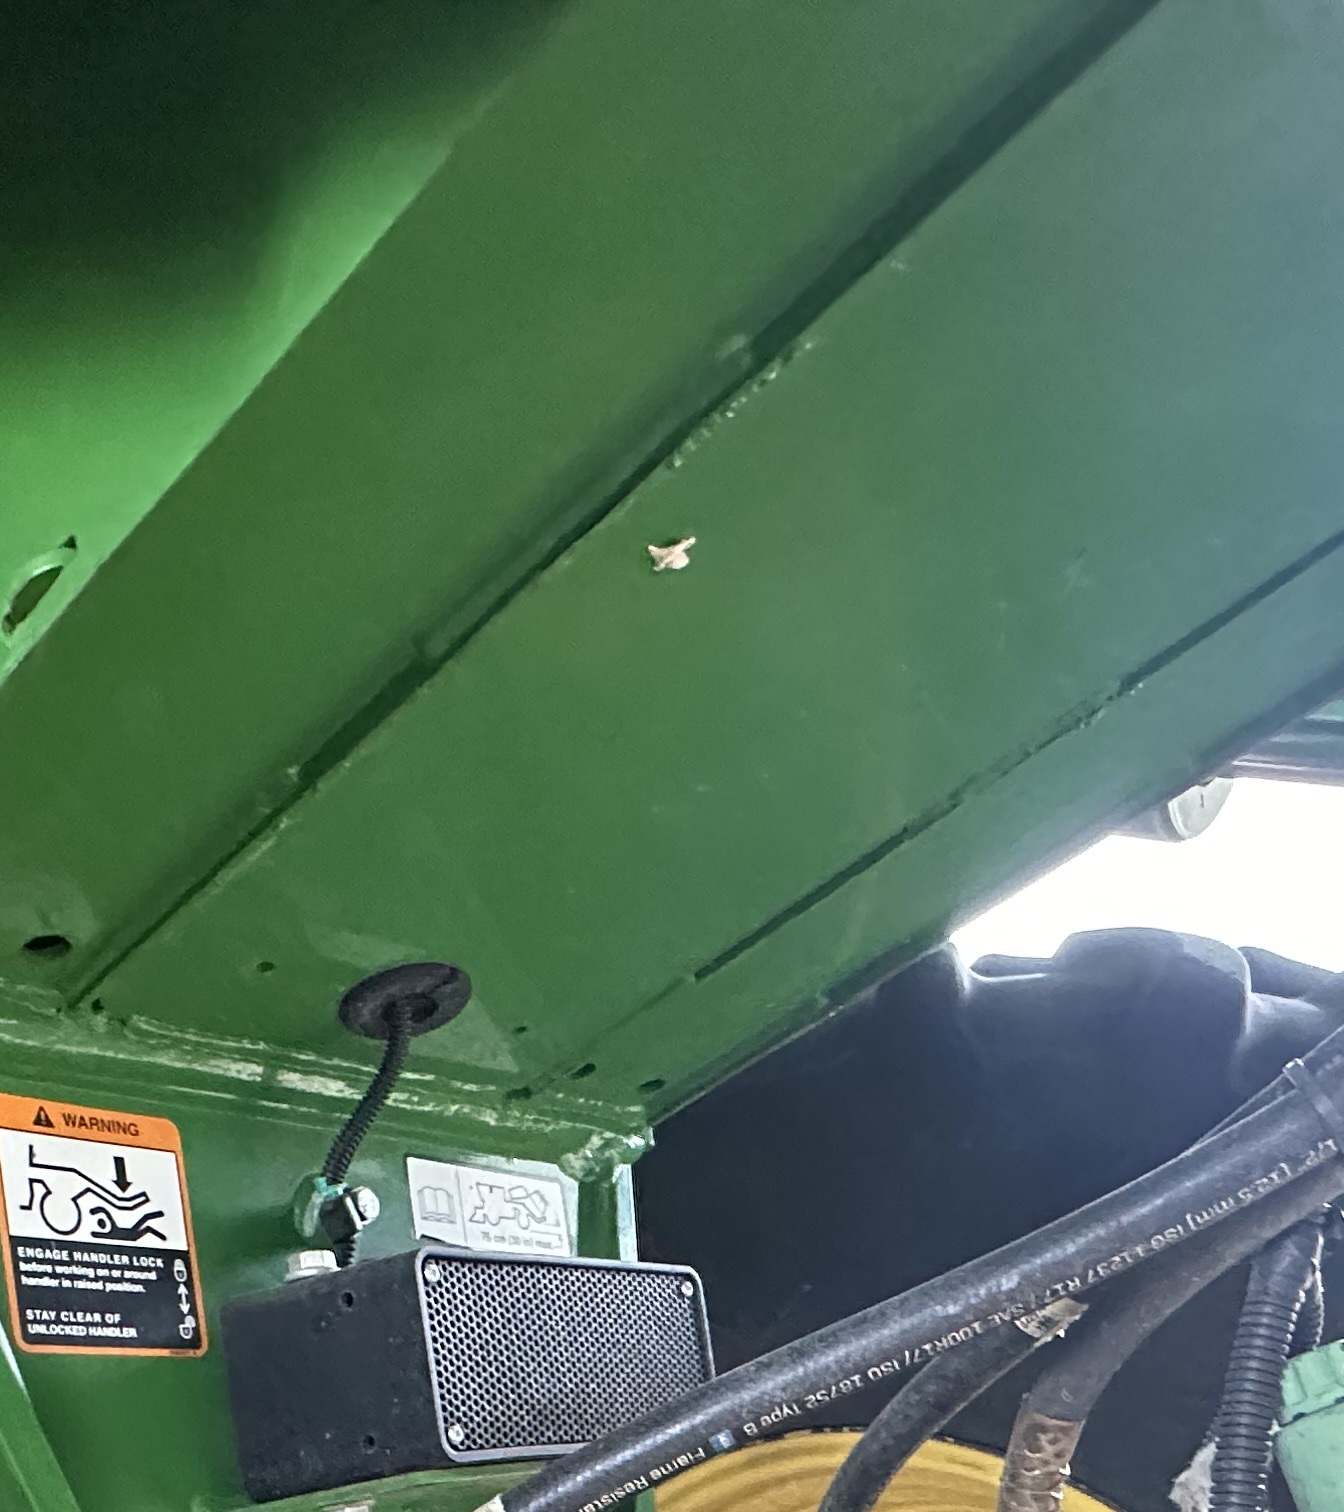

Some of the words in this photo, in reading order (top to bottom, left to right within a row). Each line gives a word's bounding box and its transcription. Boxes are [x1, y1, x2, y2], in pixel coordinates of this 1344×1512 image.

[62, 1112, 139, 1137] WARNING
[1151, 1226, 1185, 1250] ISO
[17, 1246, 69, 1261] ENGAGE
[73, 1250, 129, 1265] HANDLER
[133, 1255, 164, 1268] LOCK
[19, 1261, 52, 1274] before
[55, 1264, 95, 1278] working
[96, 1268, 110, 1277] on
[111, 1268, 122, 1278] or
[124, 1268, 156, 1280] around
[21, 1275, 60, 1288] handler
[61, 1277, 72, 1289] in
[74, 1278, 103, 1291] raised
[105, 1280, 146, 1293] position.
[1044, 1276, 1083, 1302] R17
[26, 1309, 56, 1322] STAY
[60, 1310, 102, 1323] CLEAR
[105, 1312, 121, 1323] OF
[988, 1302, 1027, 1328] SAE
[28, 1323, 86, 1337] UNLOCKED
[88, 1326, 137, 1338] HANDLER
[866, 1357, 901, 1382] ISO
[804, 1374, 864, 1409] 18752
[759, 1402, 801, 1429] Type
[743, 1421, 759, 1438] B
[648, 1446, 706, 1482] Flame
